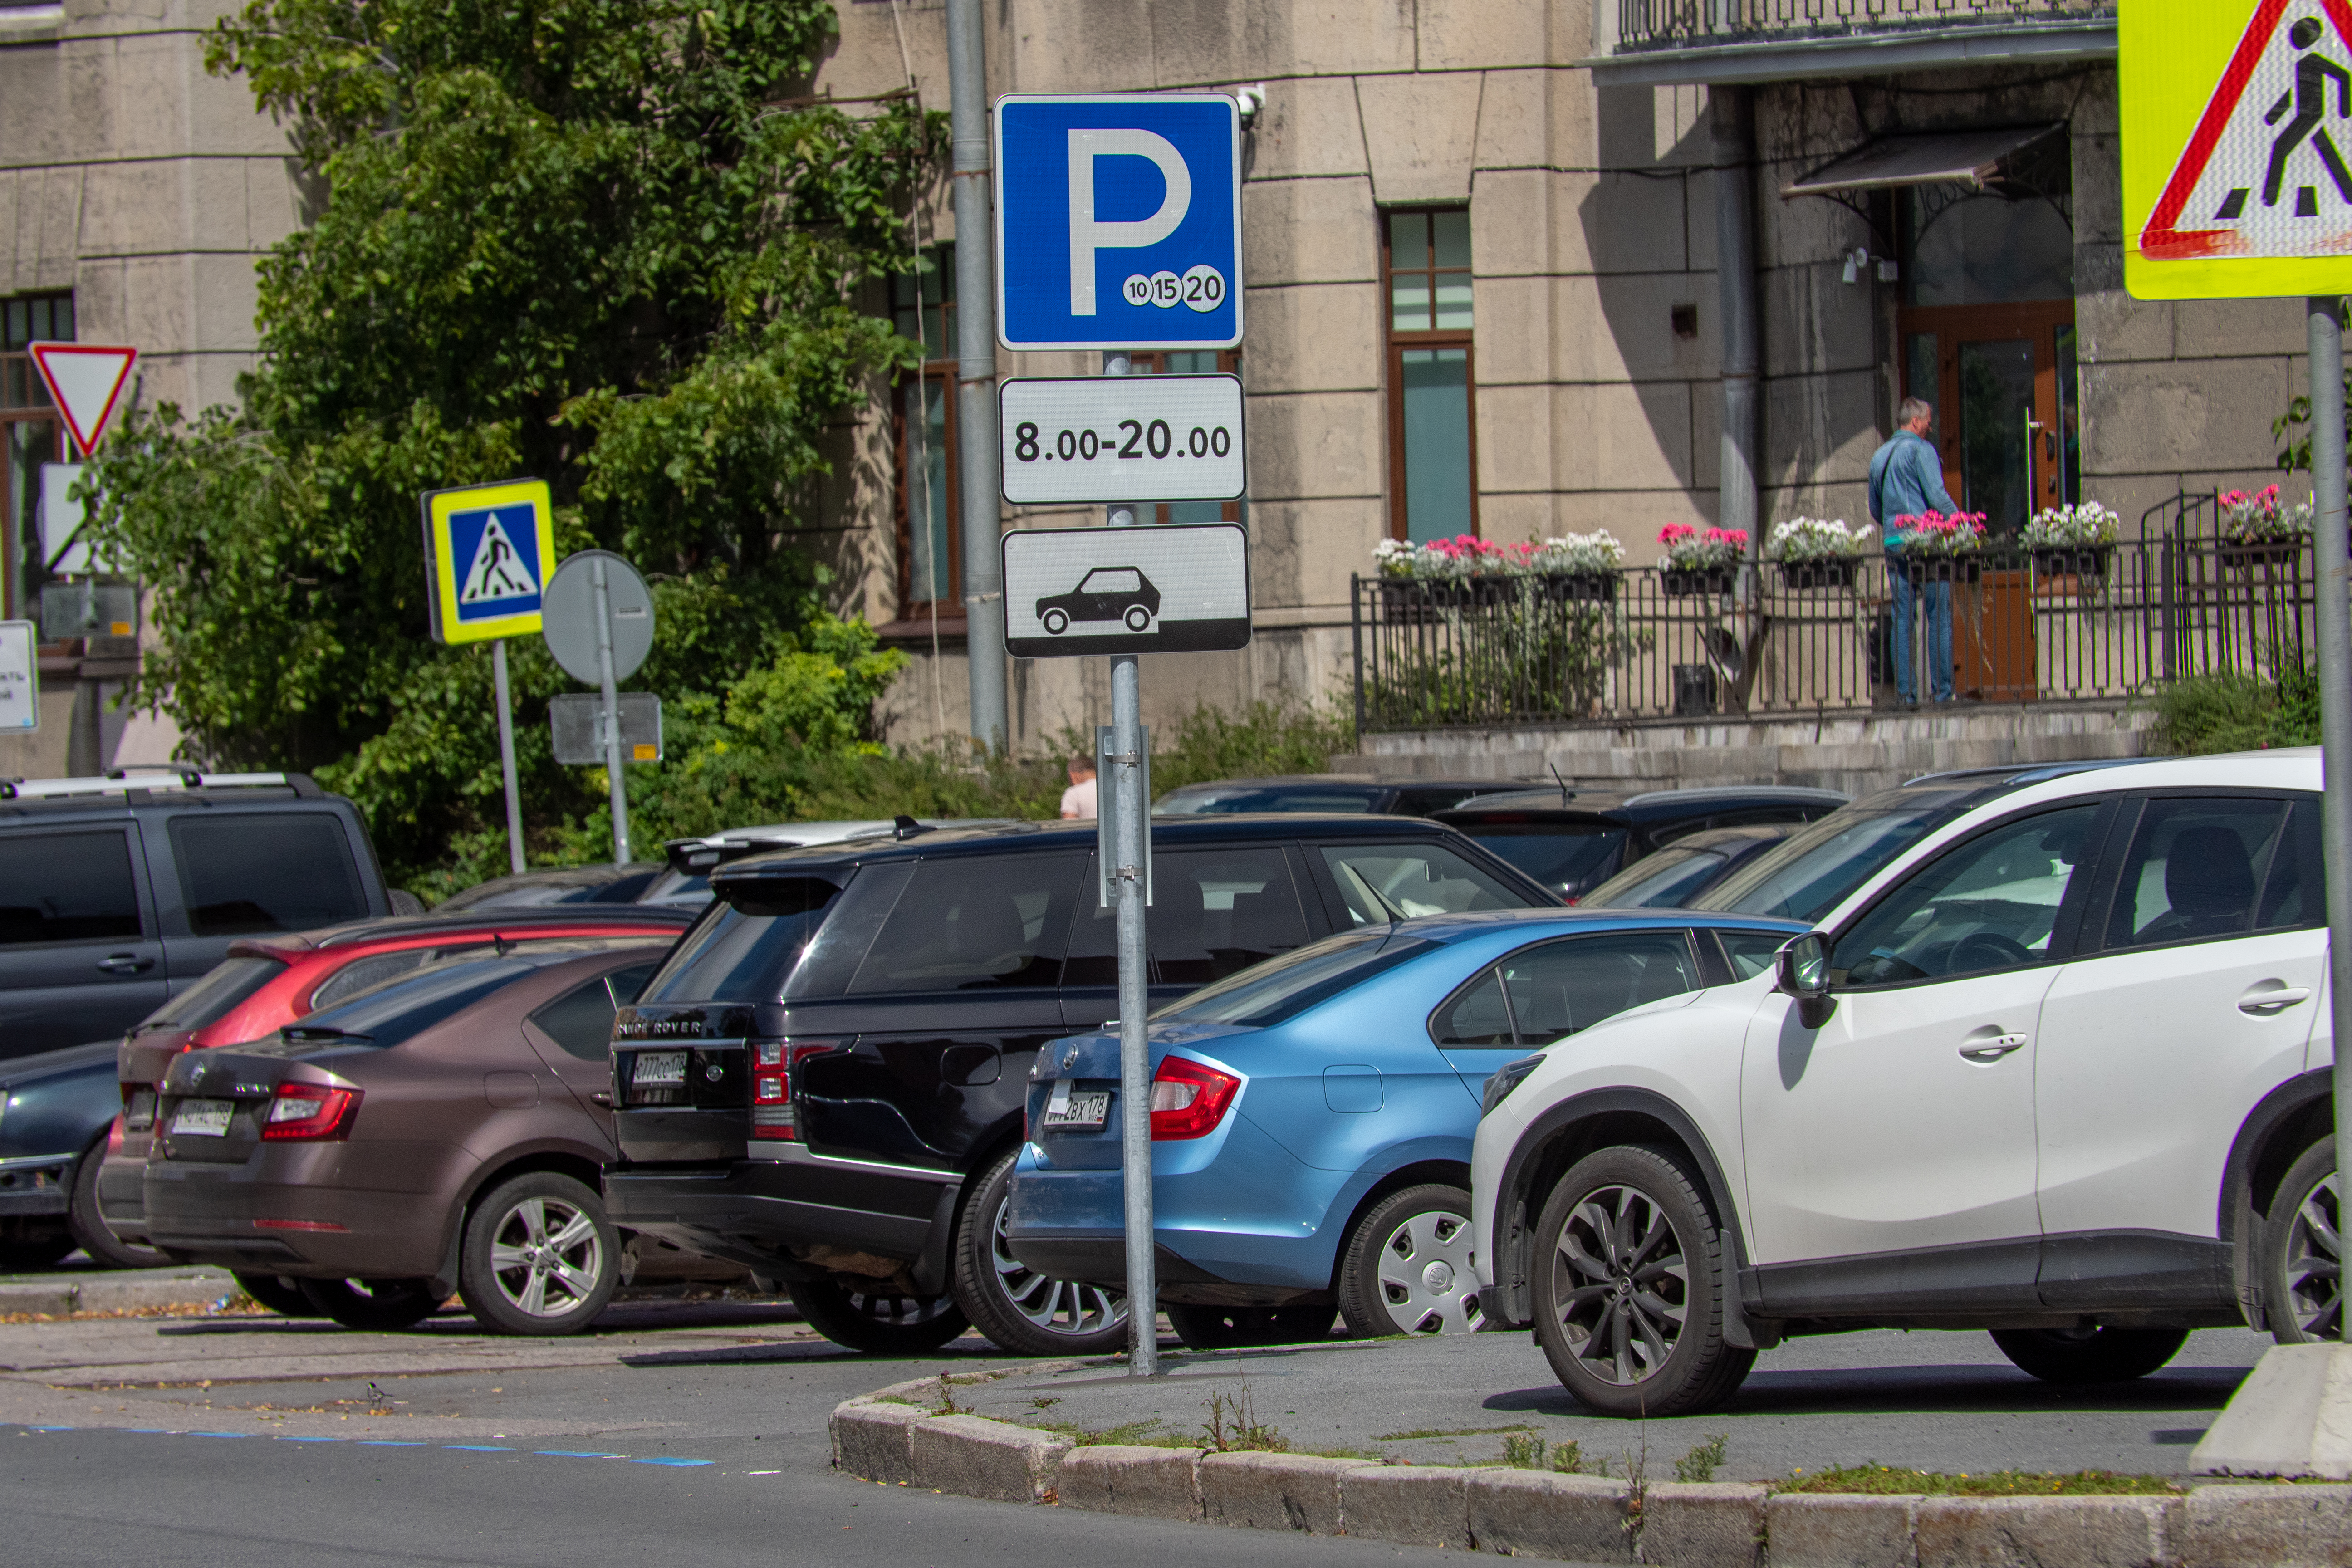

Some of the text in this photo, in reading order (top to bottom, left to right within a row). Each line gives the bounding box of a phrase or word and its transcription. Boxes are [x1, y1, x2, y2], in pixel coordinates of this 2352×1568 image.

[1068, 128, 1192, 316] P
[1129, 275, 1221, 302] 10 15 20
[1015, 418, 1230, 463] 8.00-20.00
[654, 1021, 701, 1034] ROVER
[1088, 1095, 1105, 1114] 178
